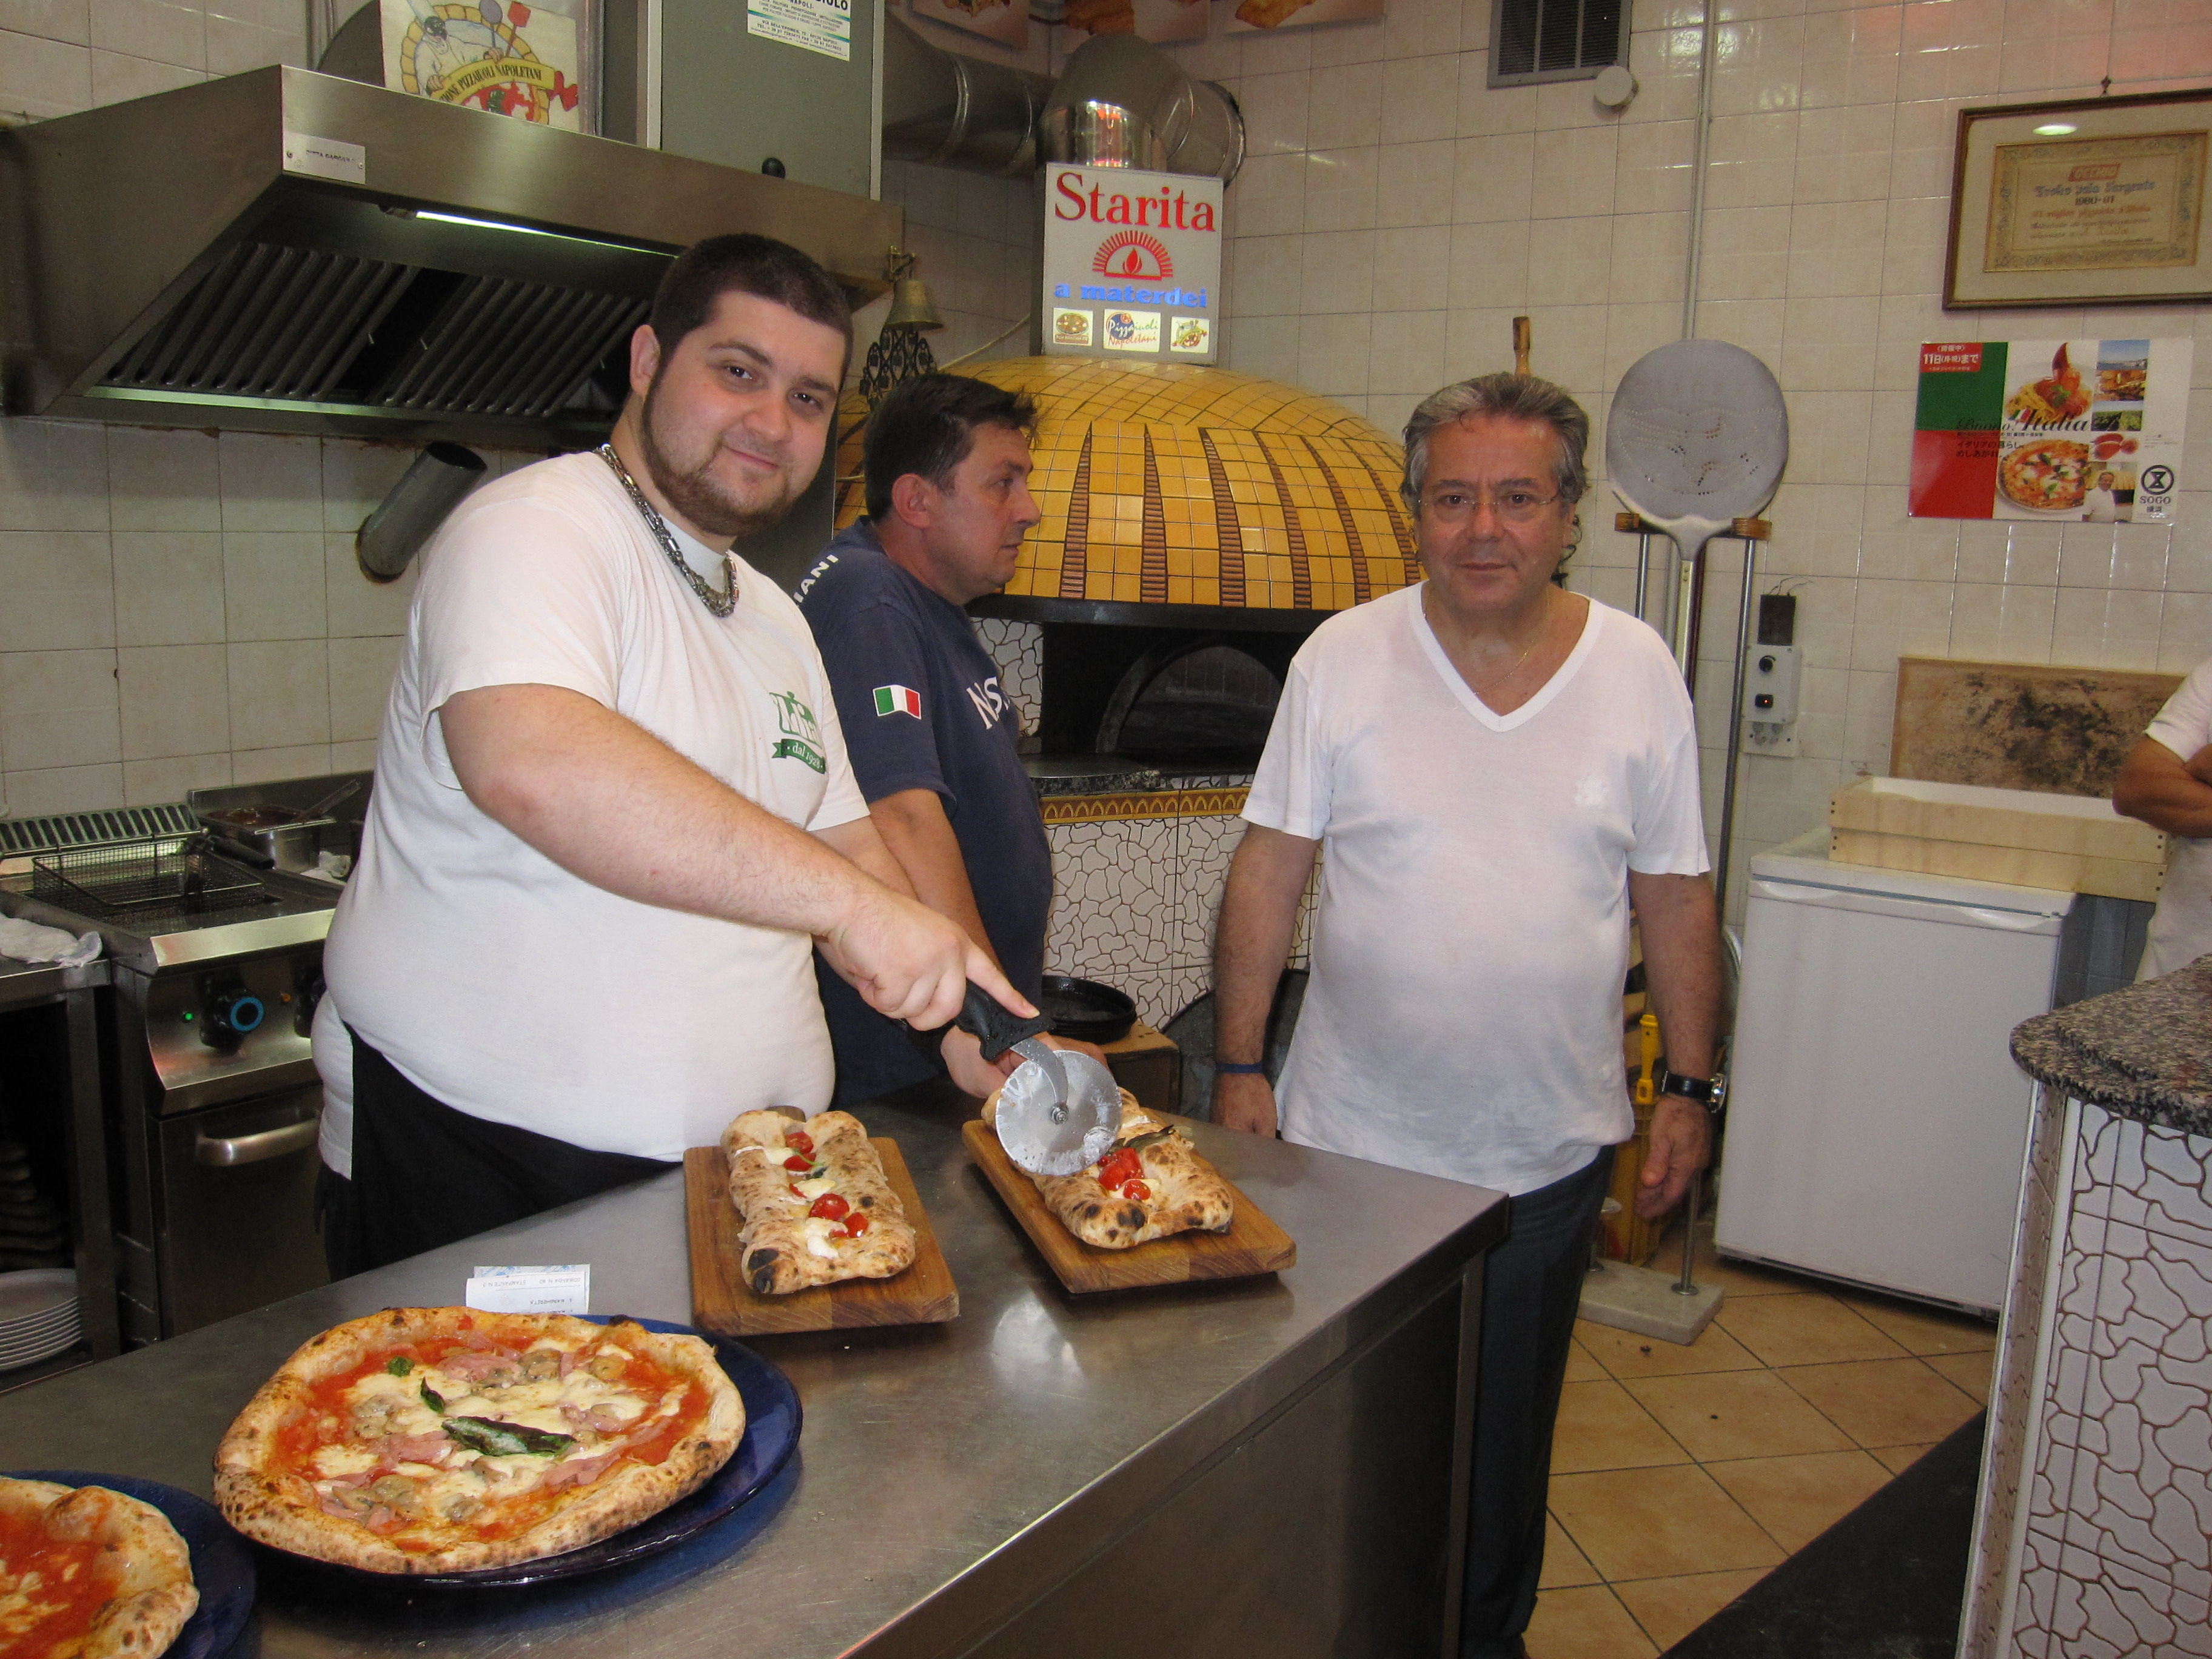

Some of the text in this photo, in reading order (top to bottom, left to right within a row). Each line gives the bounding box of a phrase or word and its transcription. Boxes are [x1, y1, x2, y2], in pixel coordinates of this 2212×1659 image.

[495, 64, 542, 81] NAPOLETANI
[1055, 172, 1216, 232] Starita
[1054, 283, 1207, 308] a materdei
[2022, 409, 2089, 431] Italia
[2139, 495, 2171, 504] SOGO
[793, 554, 839, 604] IANI
[793, 742, 806, 757] dal
